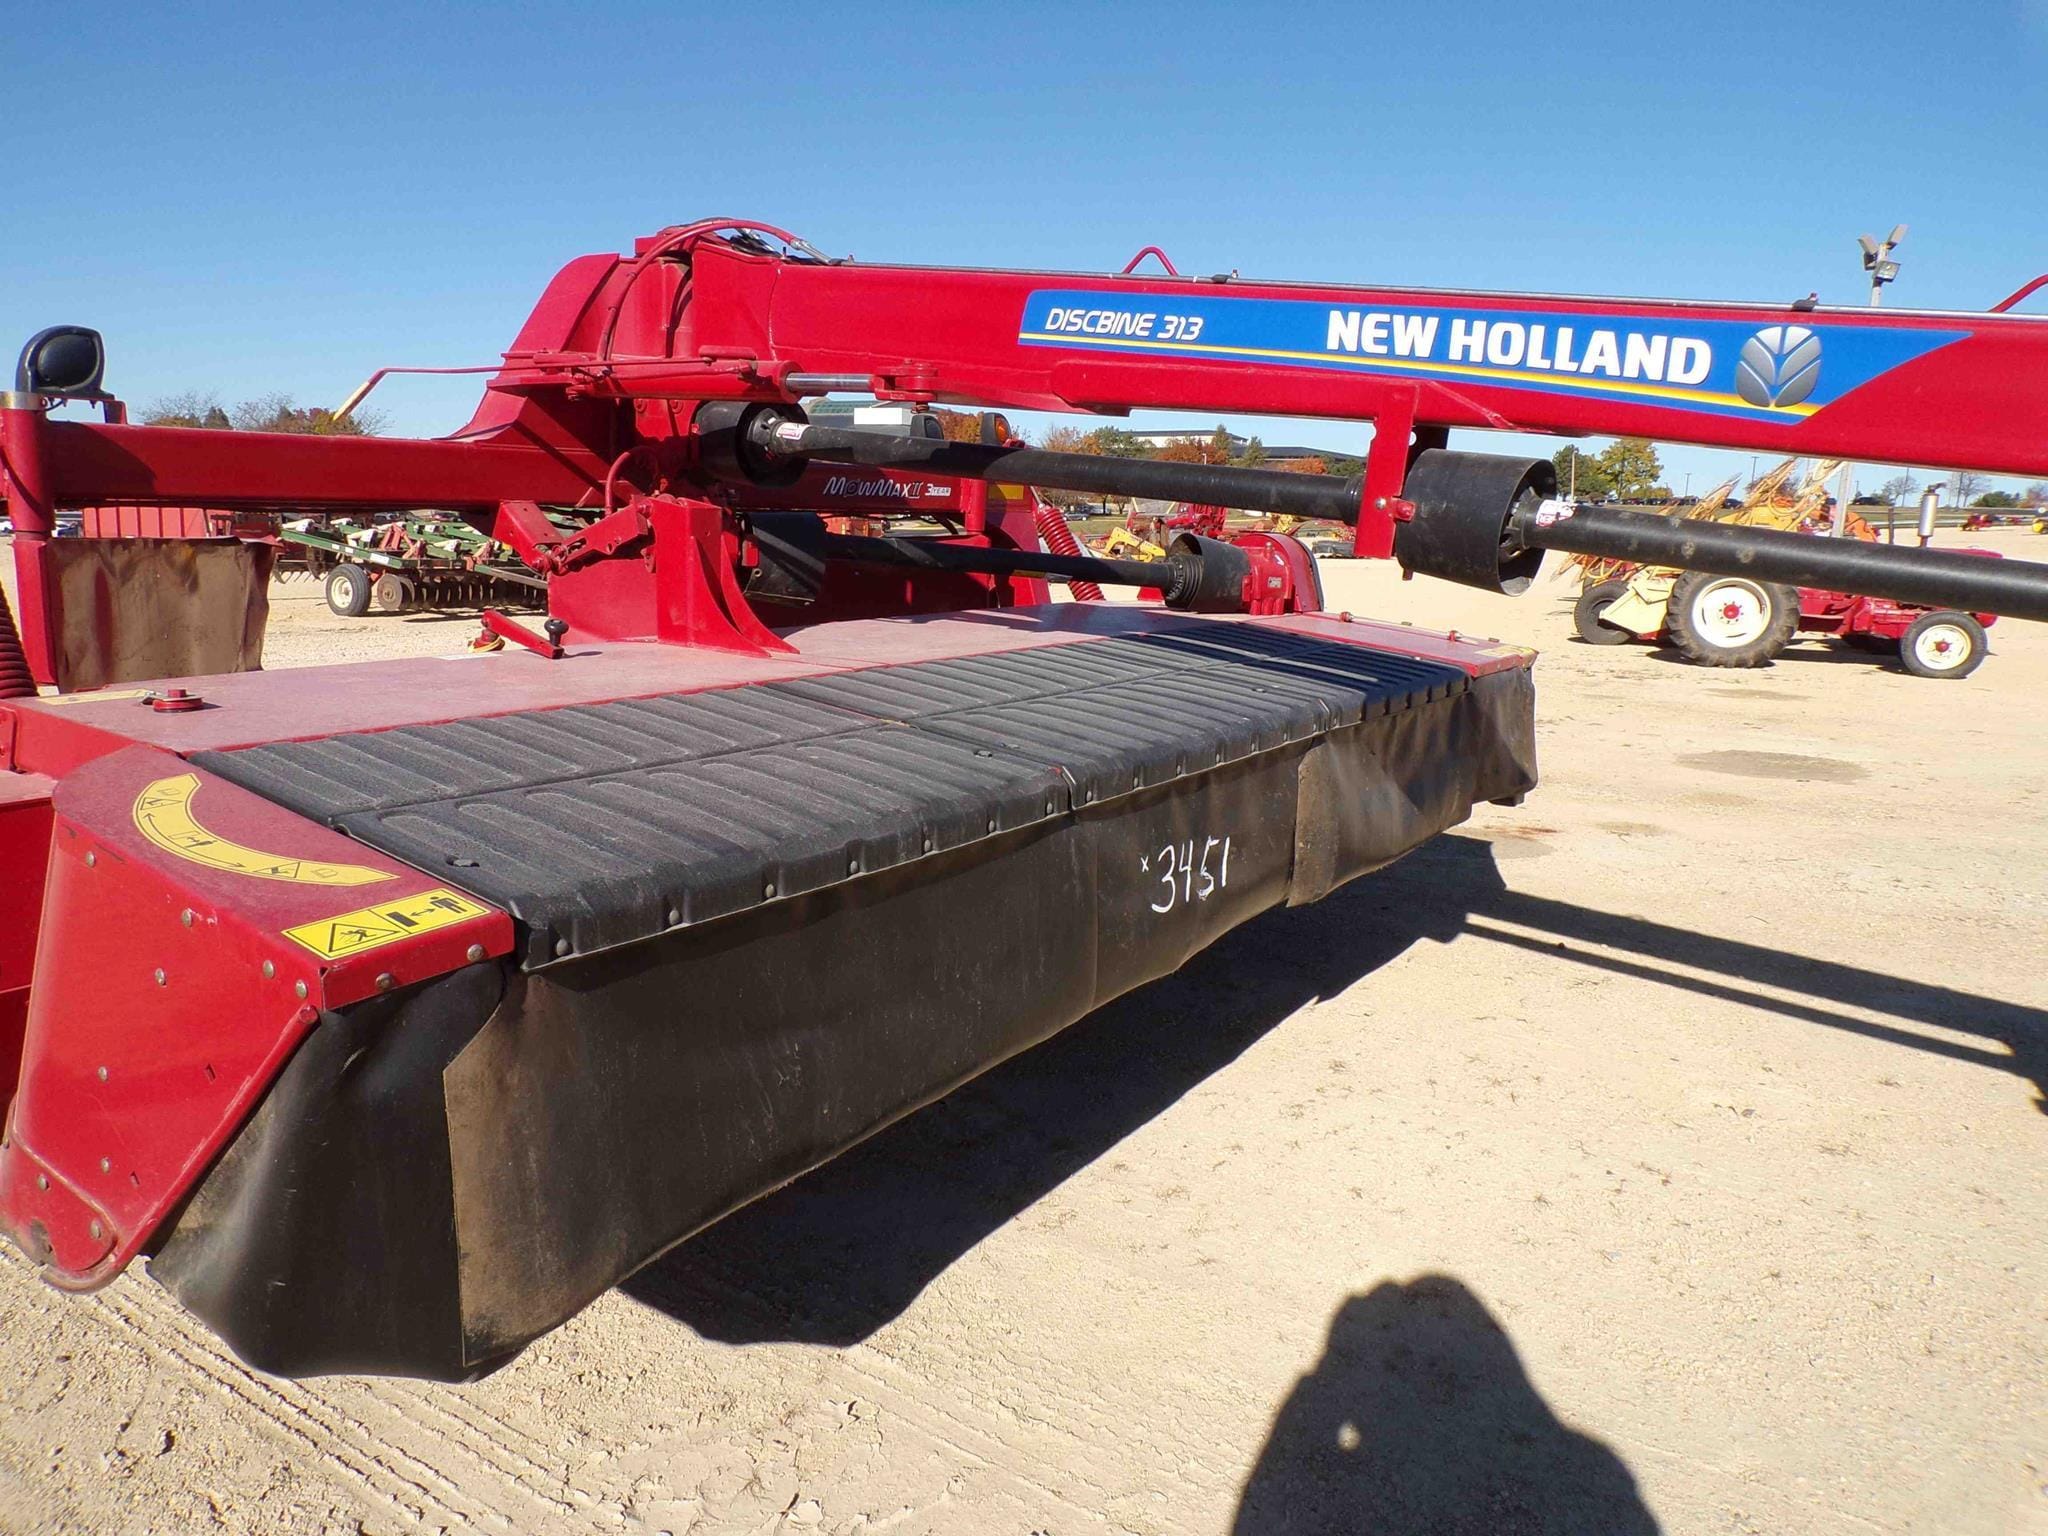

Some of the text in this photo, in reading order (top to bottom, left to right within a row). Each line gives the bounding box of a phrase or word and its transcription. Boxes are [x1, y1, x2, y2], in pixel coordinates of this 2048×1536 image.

[1045, 308, 1204, 341] DISCBINE 313
[1326, 310, 1712, 385] NEW HOLLAND
